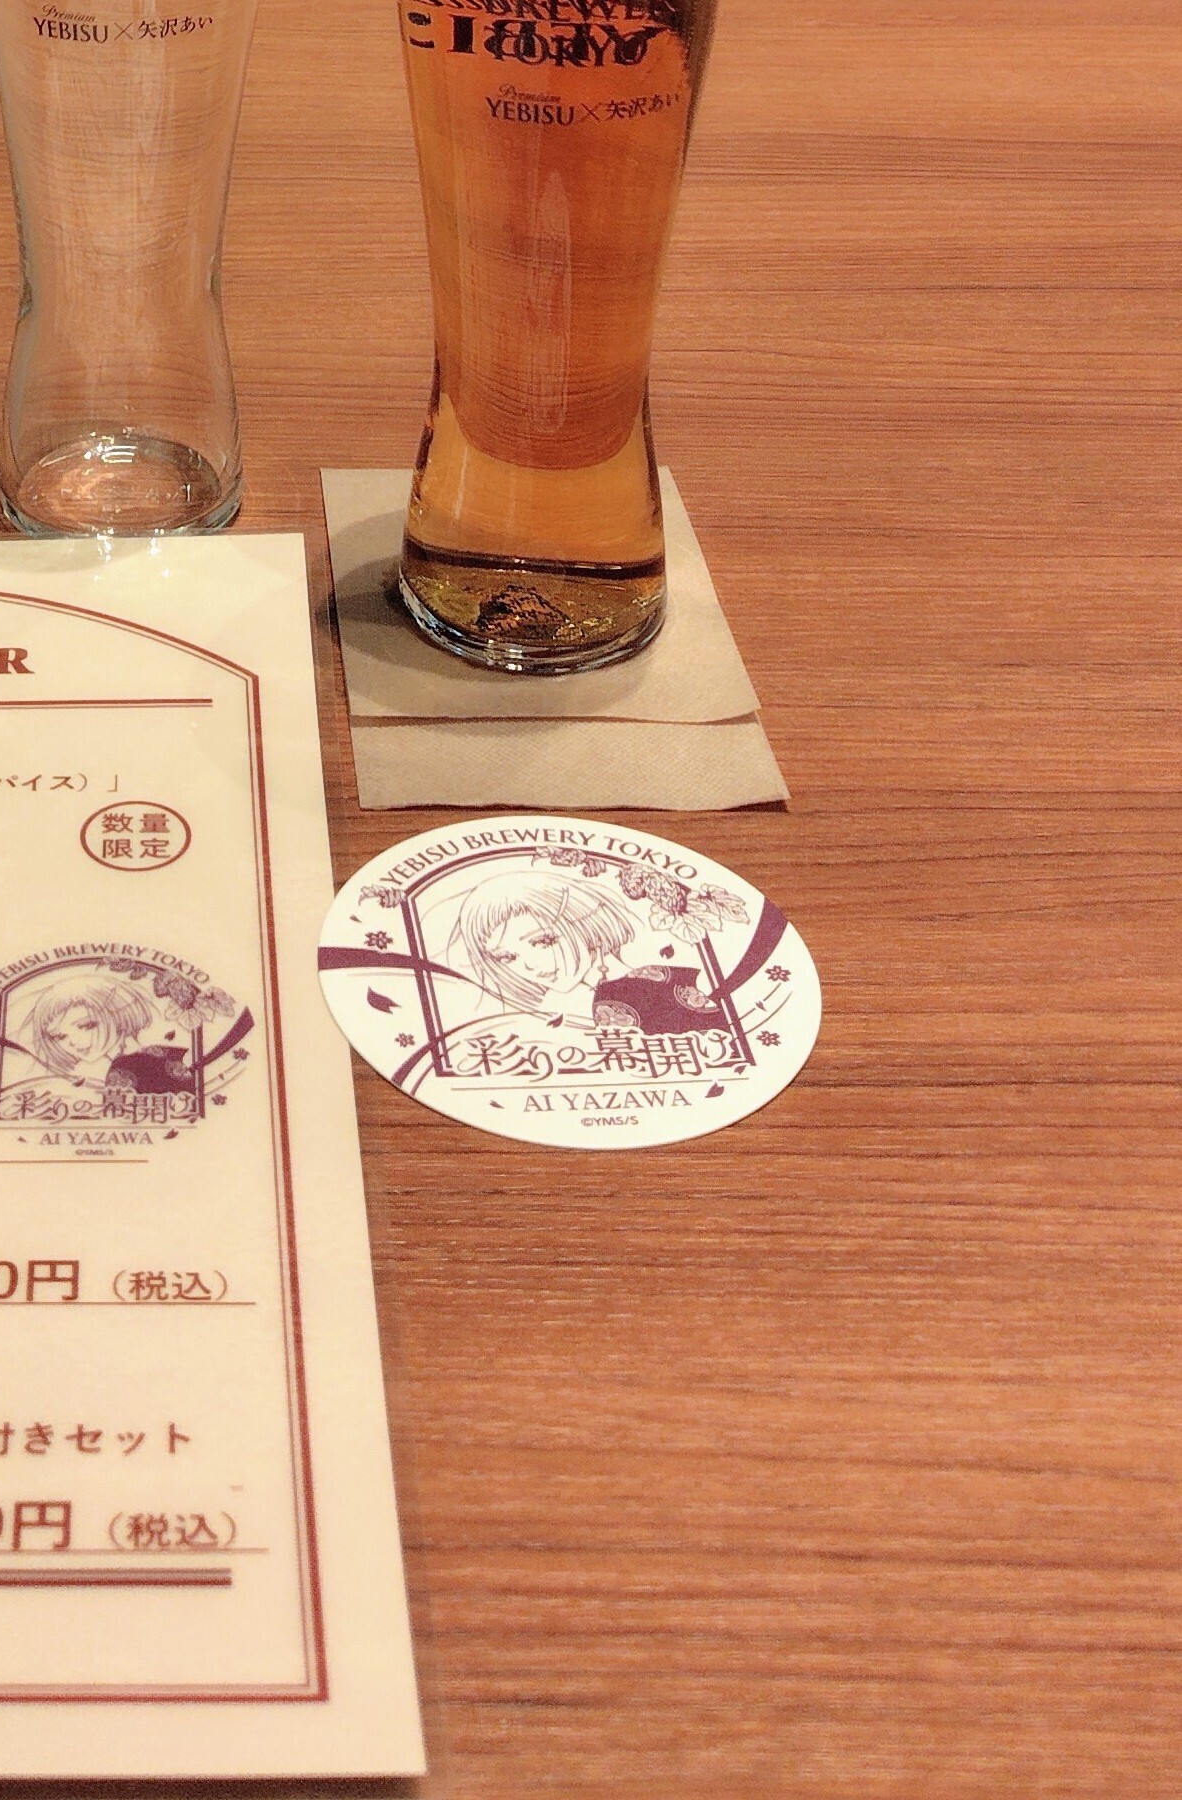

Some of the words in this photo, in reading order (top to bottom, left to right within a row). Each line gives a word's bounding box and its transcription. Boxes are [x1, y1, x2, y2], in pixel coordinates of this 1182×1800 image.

[32, 16, 109, 44] YEBISU
[138, 15, 214, 40] 矢沢あい
[485, 96, 575, 127] YEBISU
[604, 92, 681, 122] 矢沢あい
[101, 812, 171, 834] 数量
[101, 837, 171, 859] 限定
[379, 839, 460, 887] YEBISU
[462, 827, 597, 851] BREWERY
[602, 835, 699, 881] TOKYO
[52, 942, 148, 959] BREWERY
[151, 948, 211, 985] TOKYO
[458, 1027, 735, 1084] 彩りの幕開け
[523, 1093, 557, 1113] AI
[561, 1088, 693, 1112] YAZAWA
[39, 1131, 61, 1146] AI
[68, 1131, 154, 1146] YAZAWA
